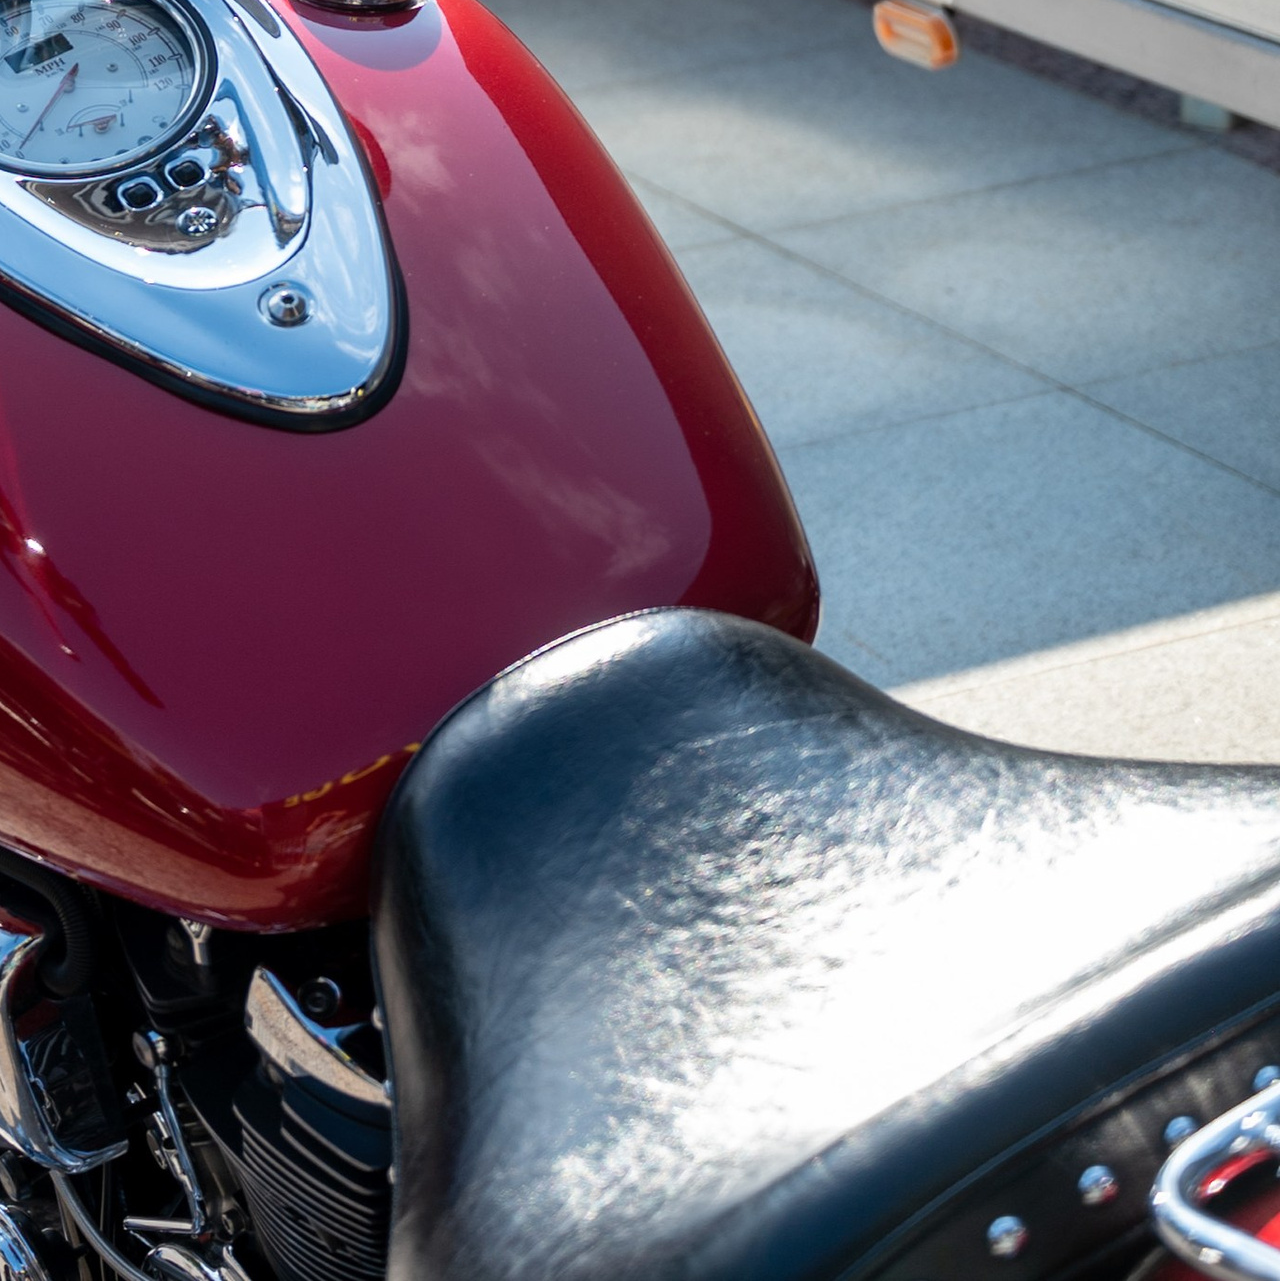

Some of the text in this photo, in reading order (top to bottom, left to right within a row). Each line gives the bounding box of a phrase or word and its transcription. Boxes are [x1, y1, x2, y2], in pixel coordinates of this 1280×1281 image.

[39, 14, 54, 26] 70
[70, 12, 86, 23] 80
[4, 25, 19, 37] 60
[106, 20, 121, 31] 90
[128, 32, 147, 46] 100
[35, 57, 66, 76] MPH
[148, 54, 166, 67] 110
[154, 77, 173, 91] 120
